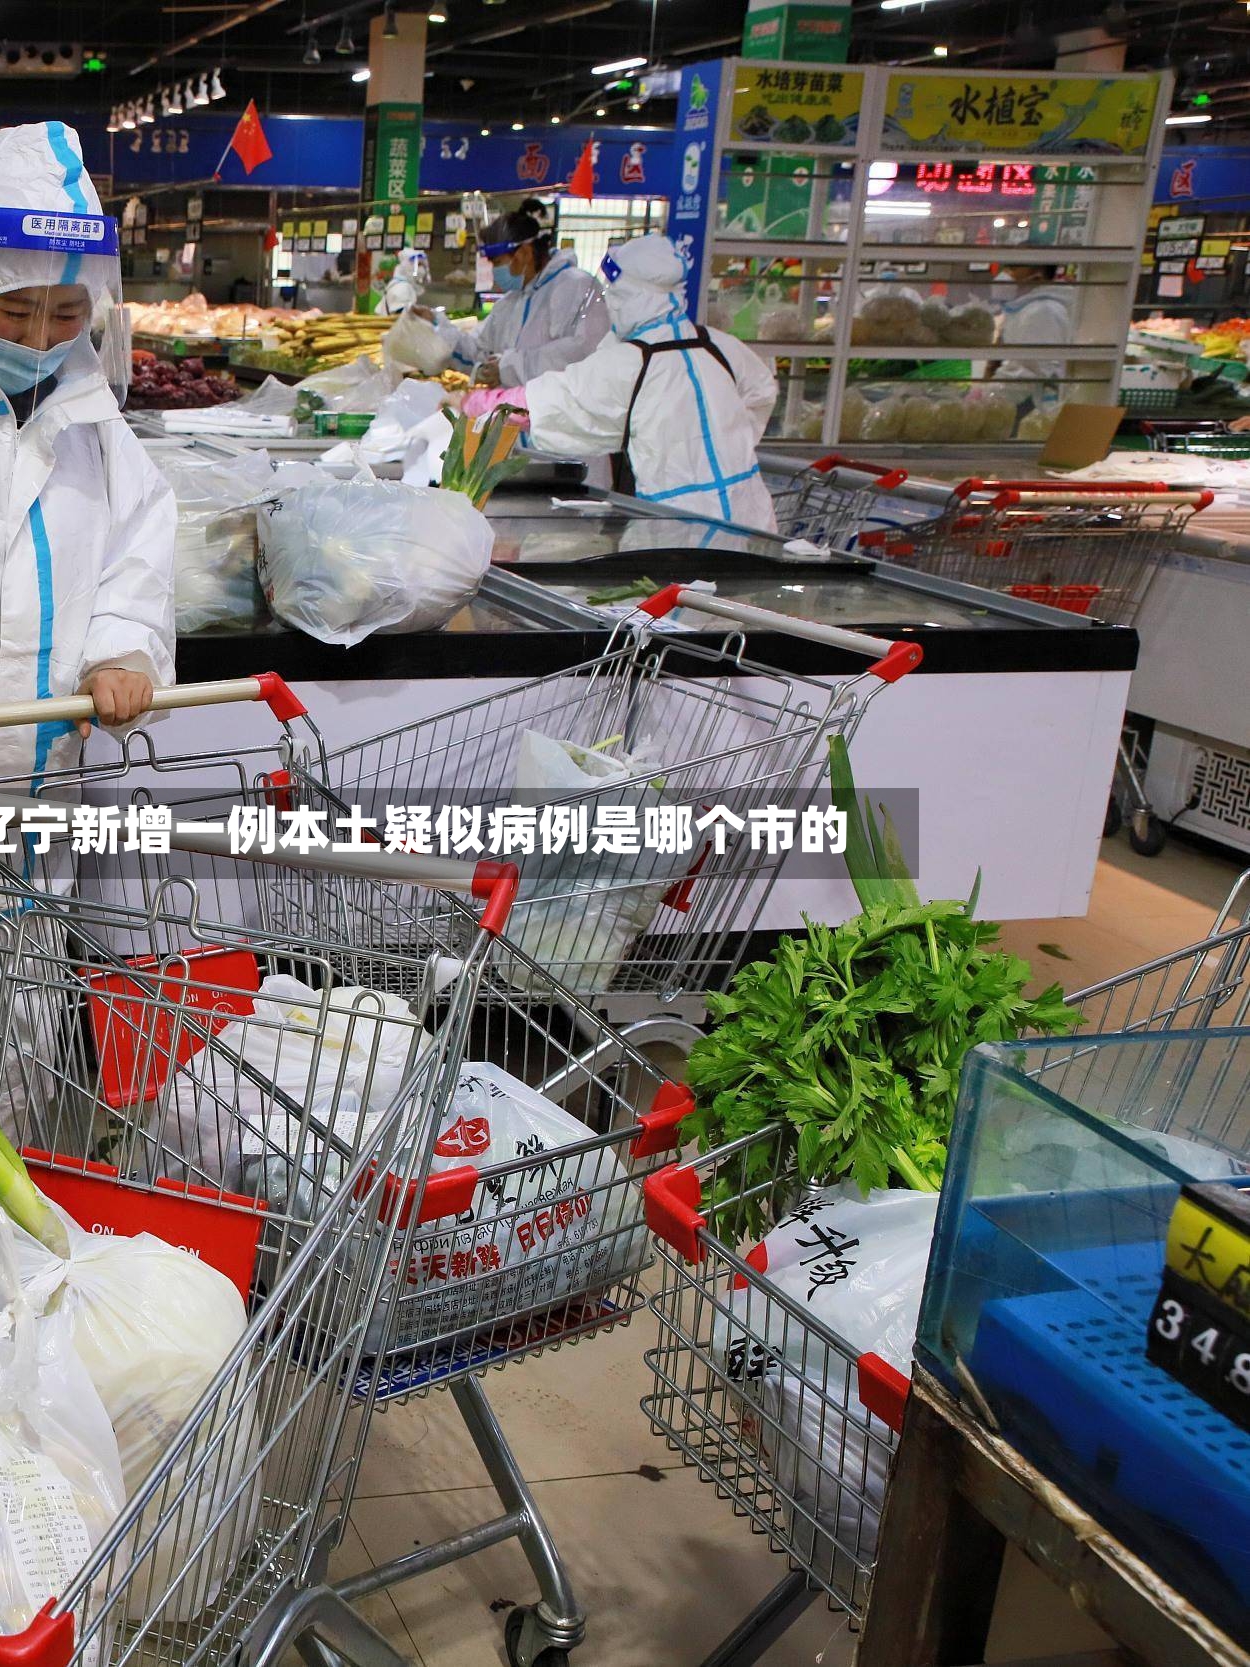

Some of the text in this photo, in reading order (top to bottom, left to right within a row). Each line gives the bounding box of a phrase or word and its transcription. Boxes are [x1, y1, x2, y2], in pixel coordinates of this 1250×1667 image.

[949, 83, 1049, 128] 水植宝
[31, 217, 101, 234] 医用隔离面罩
